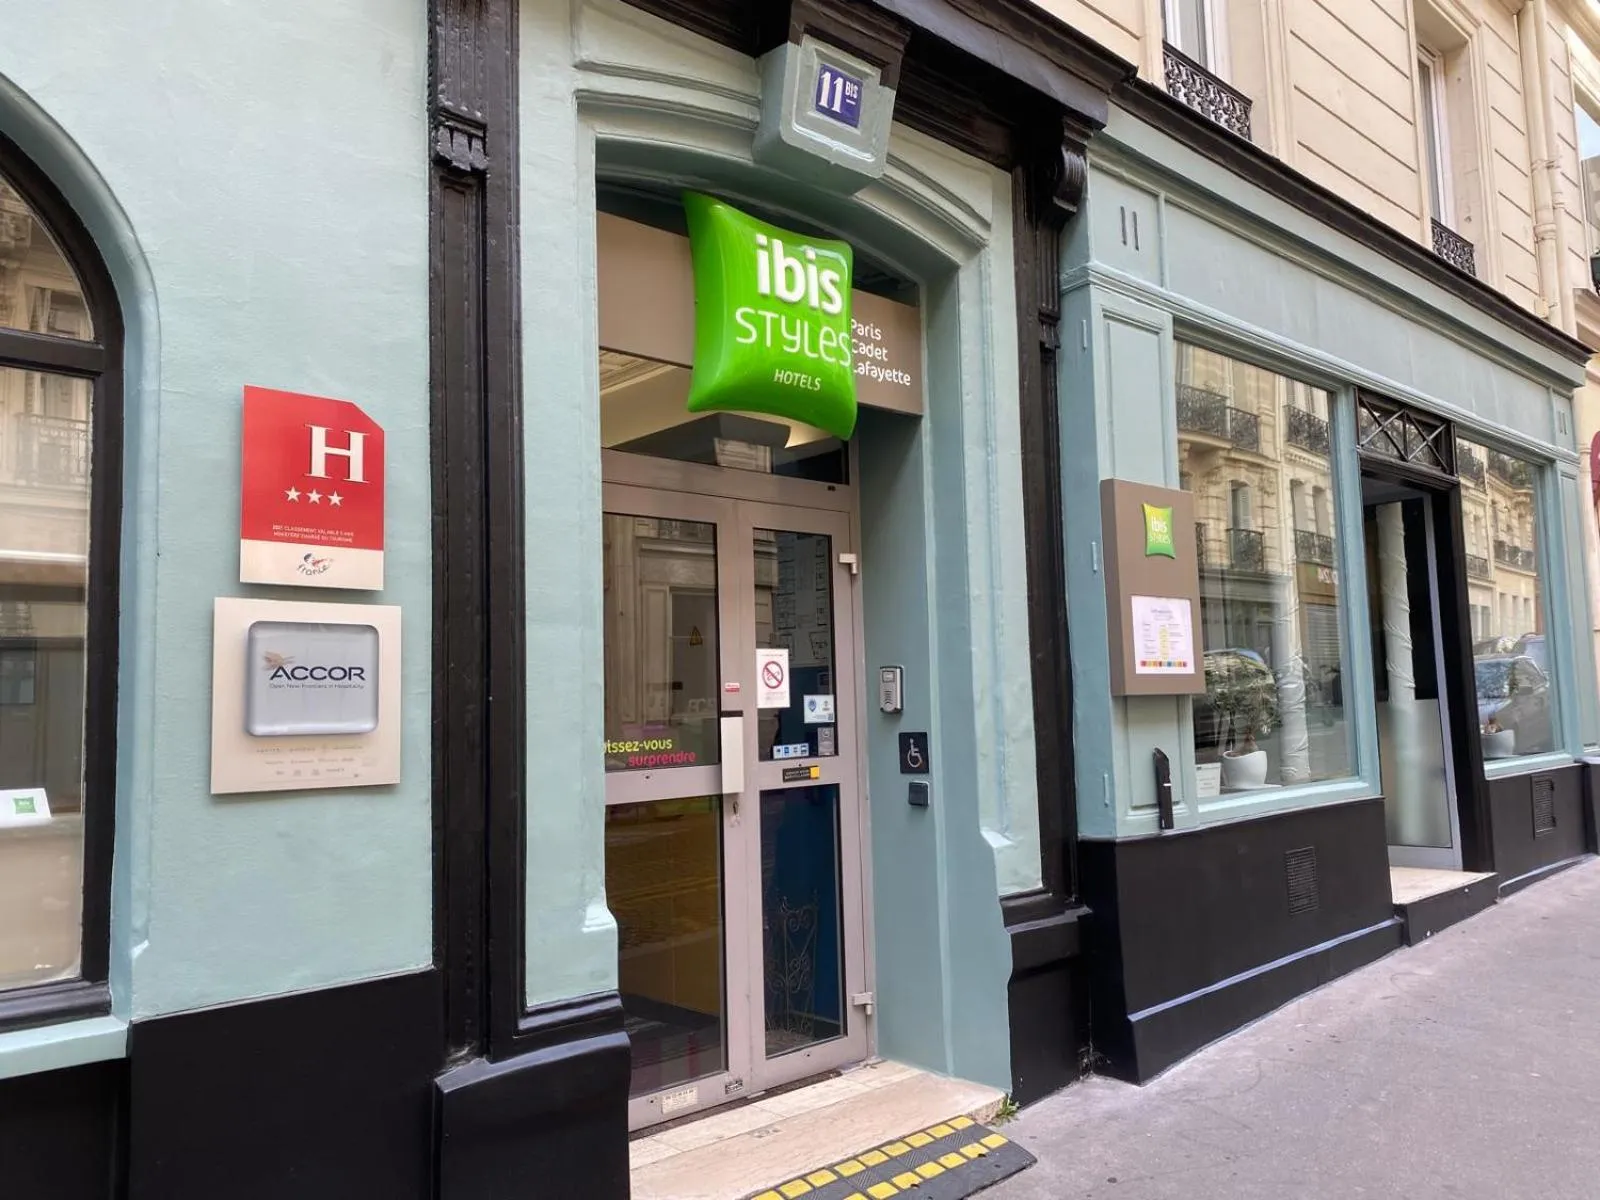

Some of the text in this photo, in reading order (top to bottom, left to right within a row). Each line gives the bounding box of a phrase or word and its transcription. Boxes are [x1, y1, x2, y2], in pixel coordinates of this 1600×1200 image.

[818, 71, 843, 113] 11
[756, 232, 843, 315] ibis
[851, 318, 882, 340] Paris
[851, 339, 888, 362] Cadet
[773, 368, 821, 391] HOTELS
[853, 361, 911, 386] afayette
[304, 424, 371, 484] H
[269, 666, 365, 681] ACCOR
[628, 751, 697, 767] surprendre
